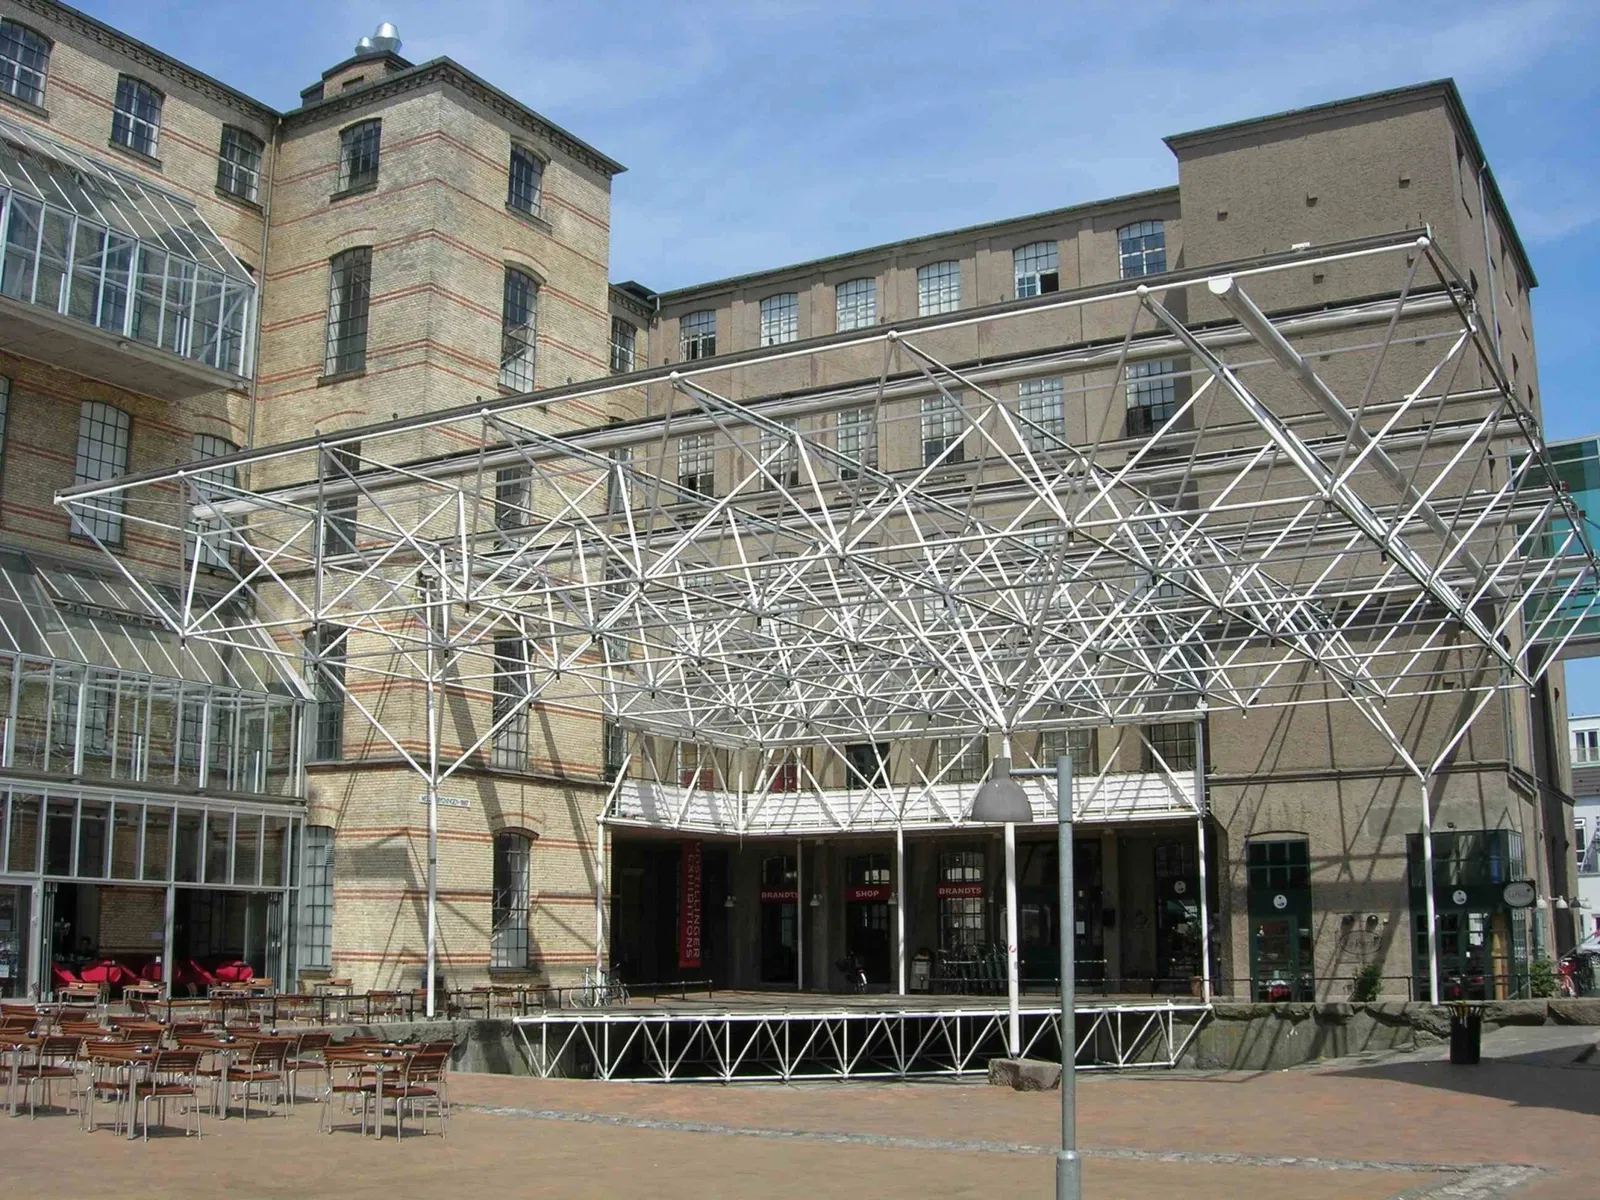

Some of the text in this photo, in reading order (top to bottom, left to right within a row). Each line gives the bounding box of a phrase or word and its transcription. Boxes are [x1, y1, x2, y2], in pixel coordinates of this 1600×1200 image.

[855, 890, 880, 898] SHOP
[938, 887, 982, 895] BRANDTS
[686, 854, 694, 958] EXHIBITIONS
